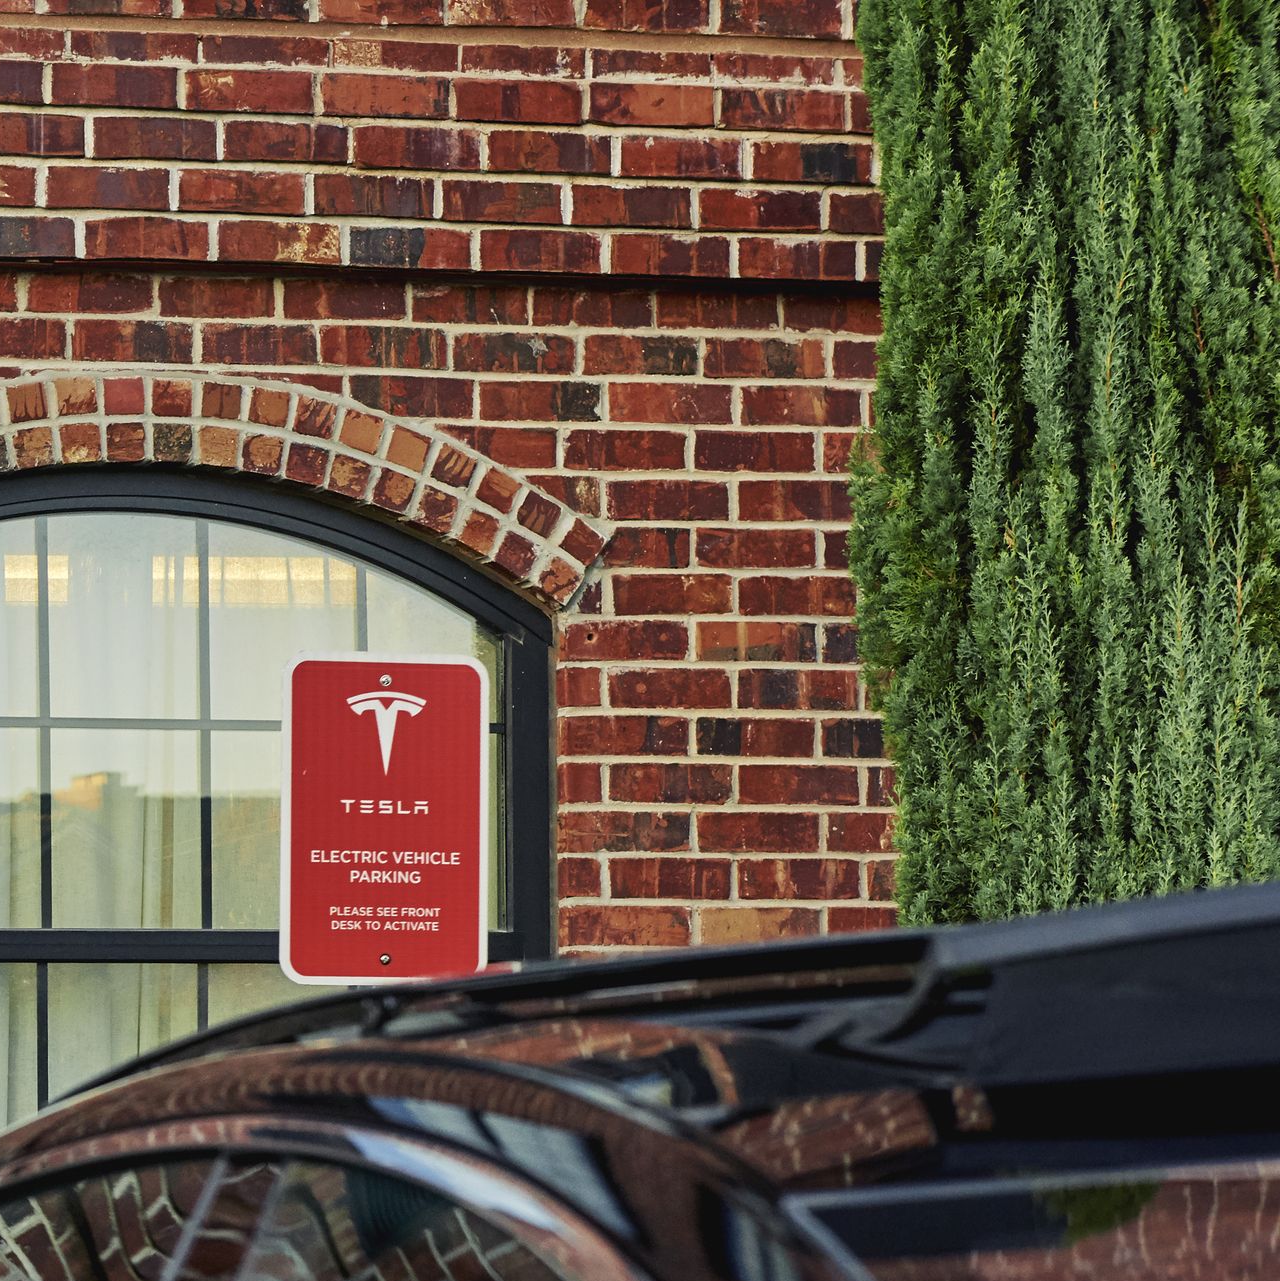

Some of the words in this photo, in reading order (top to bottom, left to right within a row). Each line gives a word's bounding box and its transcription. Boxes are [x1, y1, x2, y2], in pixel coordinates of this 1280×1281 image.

[339, 799, 429, 814] TESLA
[310, 849, 388, 864] ELECTRIC
[392, 851, 461, 865] VEHICLE
[349, 870, 422, 884] PARKING
[329, 906, 374, 917] PLEASE
[376, 906, 399, 917] SEE
[400, 906, 441, 917] FRONT
[330, 919, 362, 930] DESK
[365, 919, 381, 931] TO
[383, 920, 440, 931] ACTIVATE
